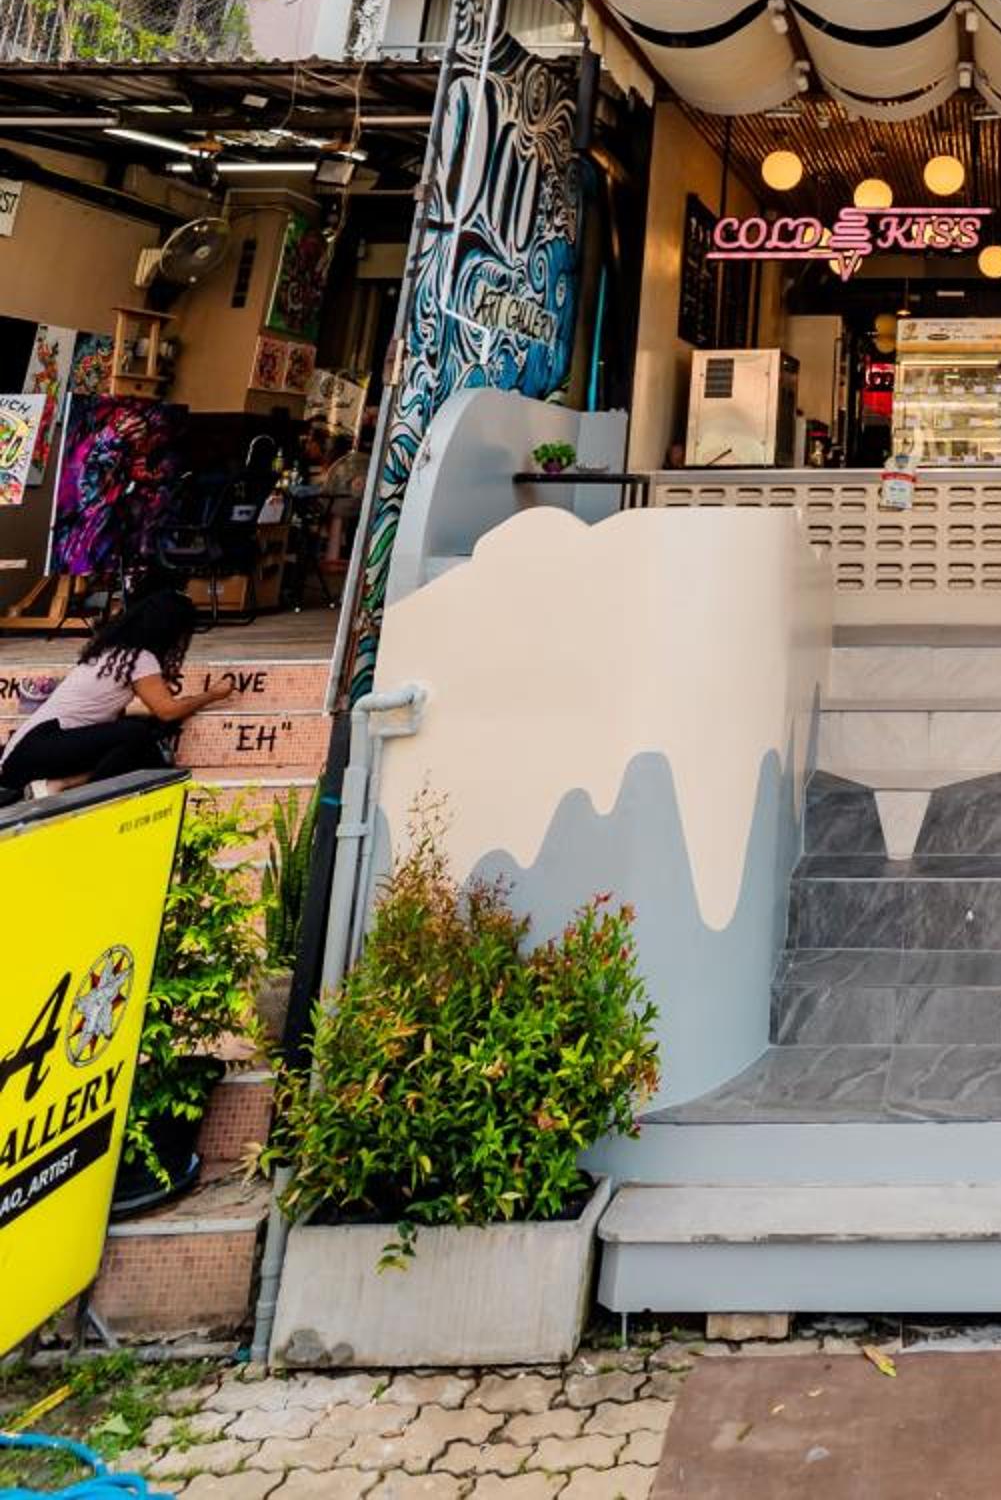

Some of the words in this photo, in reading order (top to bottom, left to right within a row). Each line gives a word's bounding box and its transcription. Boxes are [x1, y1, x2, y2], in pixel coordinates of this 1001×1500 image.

[714, 217, 823, 249] COLD
[877, 216, 982, 249] KISS
[474, 285, 505, 327] ART
[223, 721, 292, 752] "EH"
